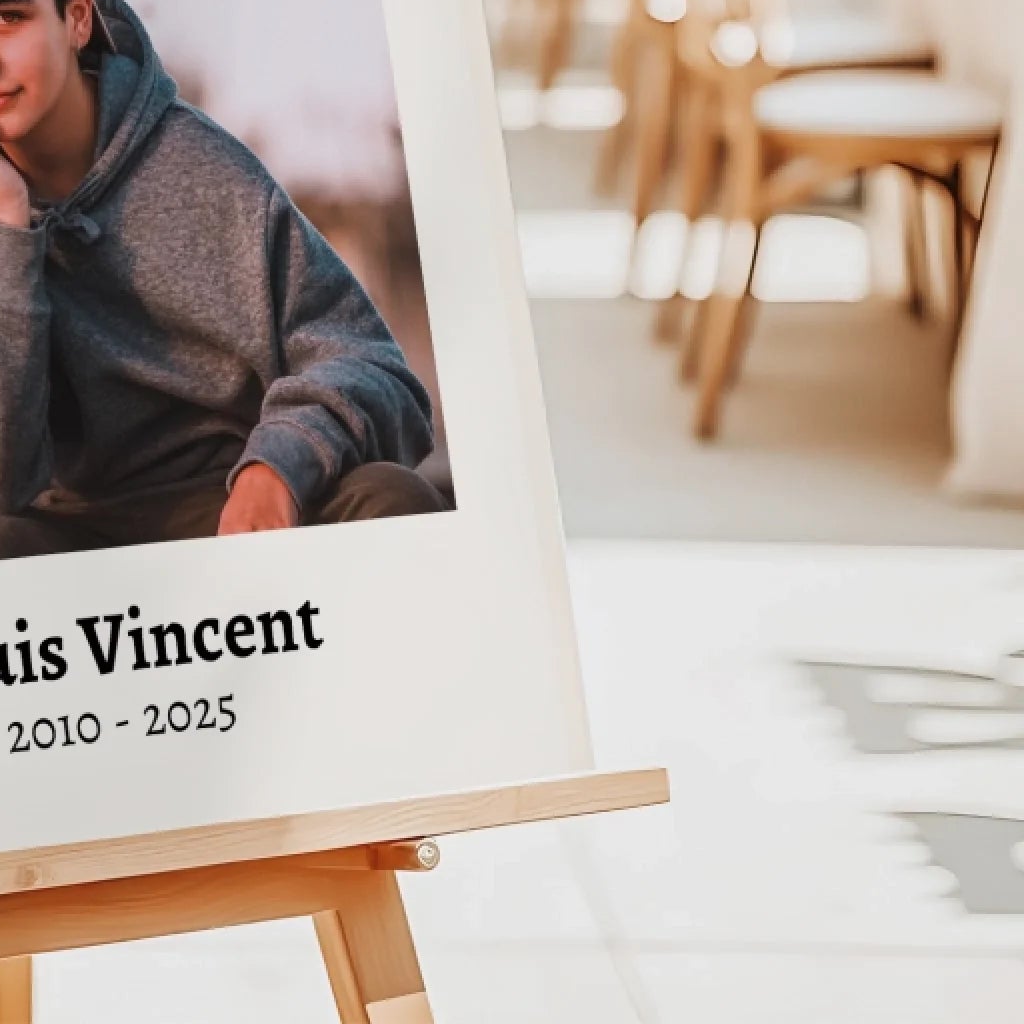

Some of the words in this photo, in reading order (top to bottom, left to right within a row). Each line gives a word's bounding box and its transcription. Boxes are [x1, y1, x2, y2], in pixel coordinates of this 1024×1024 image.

[75, 599, 325, 675] Vincent
[7, 712, 102, 754] 2010
[142, 693, 238, 738] 2025
